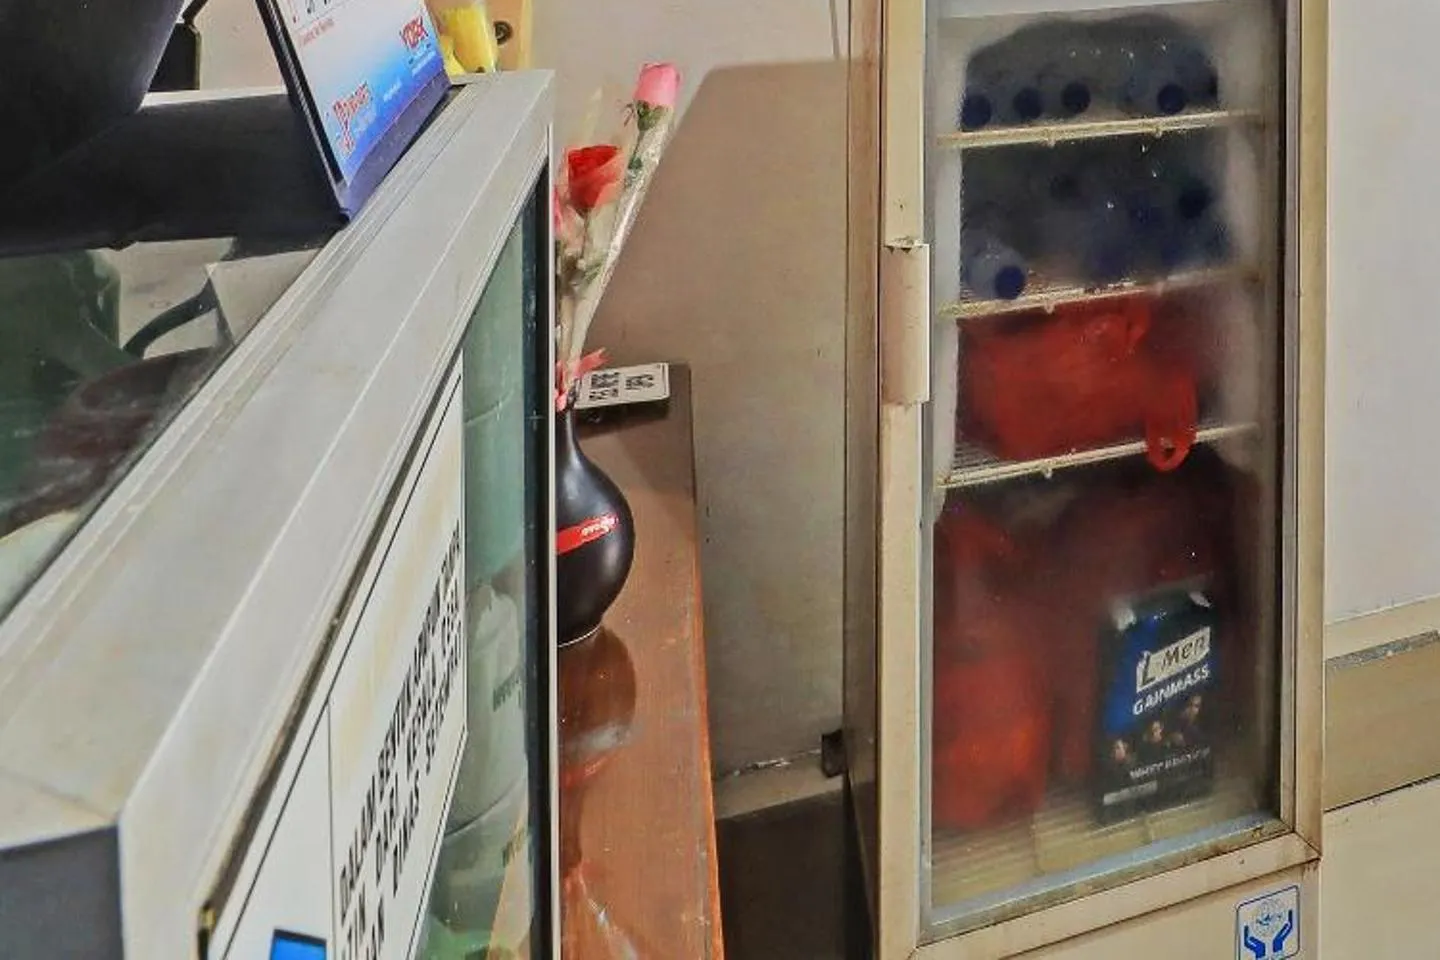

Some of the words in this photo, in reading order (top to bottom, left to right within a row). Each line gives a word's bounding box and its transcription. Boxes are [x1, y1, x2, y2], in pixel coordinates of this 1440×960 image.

[1132, 662, 1210, 716] GAINMASS
[339, 773, 376, 928] DALAM
[378, 663, 412, 804] BENTUK
[376, 772, 399, 888] DARI
[393, 768, 420, 900] DINAS
